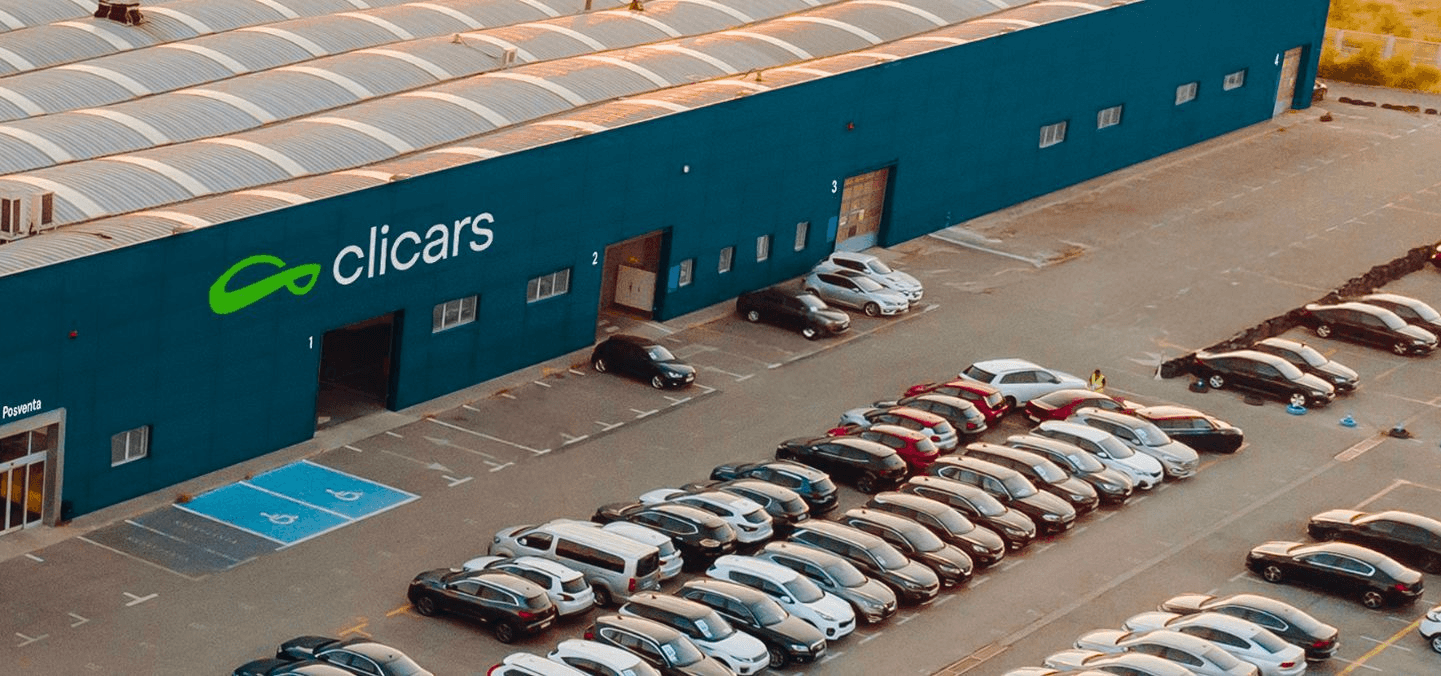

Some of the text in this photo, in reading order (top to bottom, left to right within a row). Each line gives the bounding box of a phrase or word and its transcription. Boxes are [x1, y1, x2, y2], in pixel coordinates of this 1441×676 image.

[831, 180, 838, 194] 3
[333, 212, 495, 285] clicars
[592, 251, 598, 265] 2
[308, 335, 313, 349] 1
[2, 399, 42, 419] Posventa
